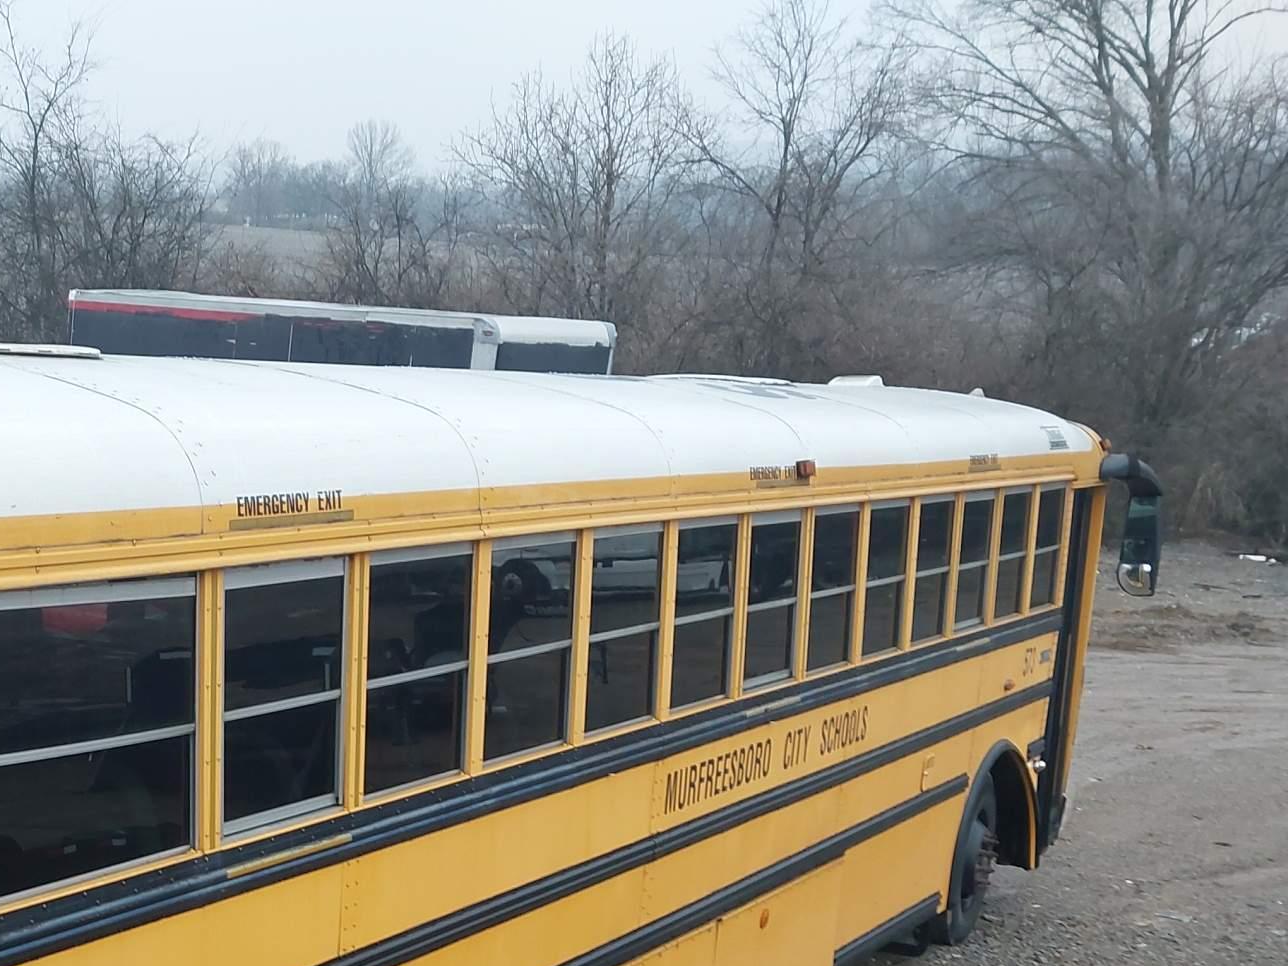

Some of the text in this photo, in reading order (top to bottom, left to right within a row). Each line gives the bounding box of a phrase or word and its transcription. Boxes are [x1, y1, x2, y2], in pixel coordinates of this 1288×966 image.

[236, 489, 342, 517] EMERGENCY EXIT
[664, 705, 870, 815] MURFREESBORO CITY SCHOOLS
